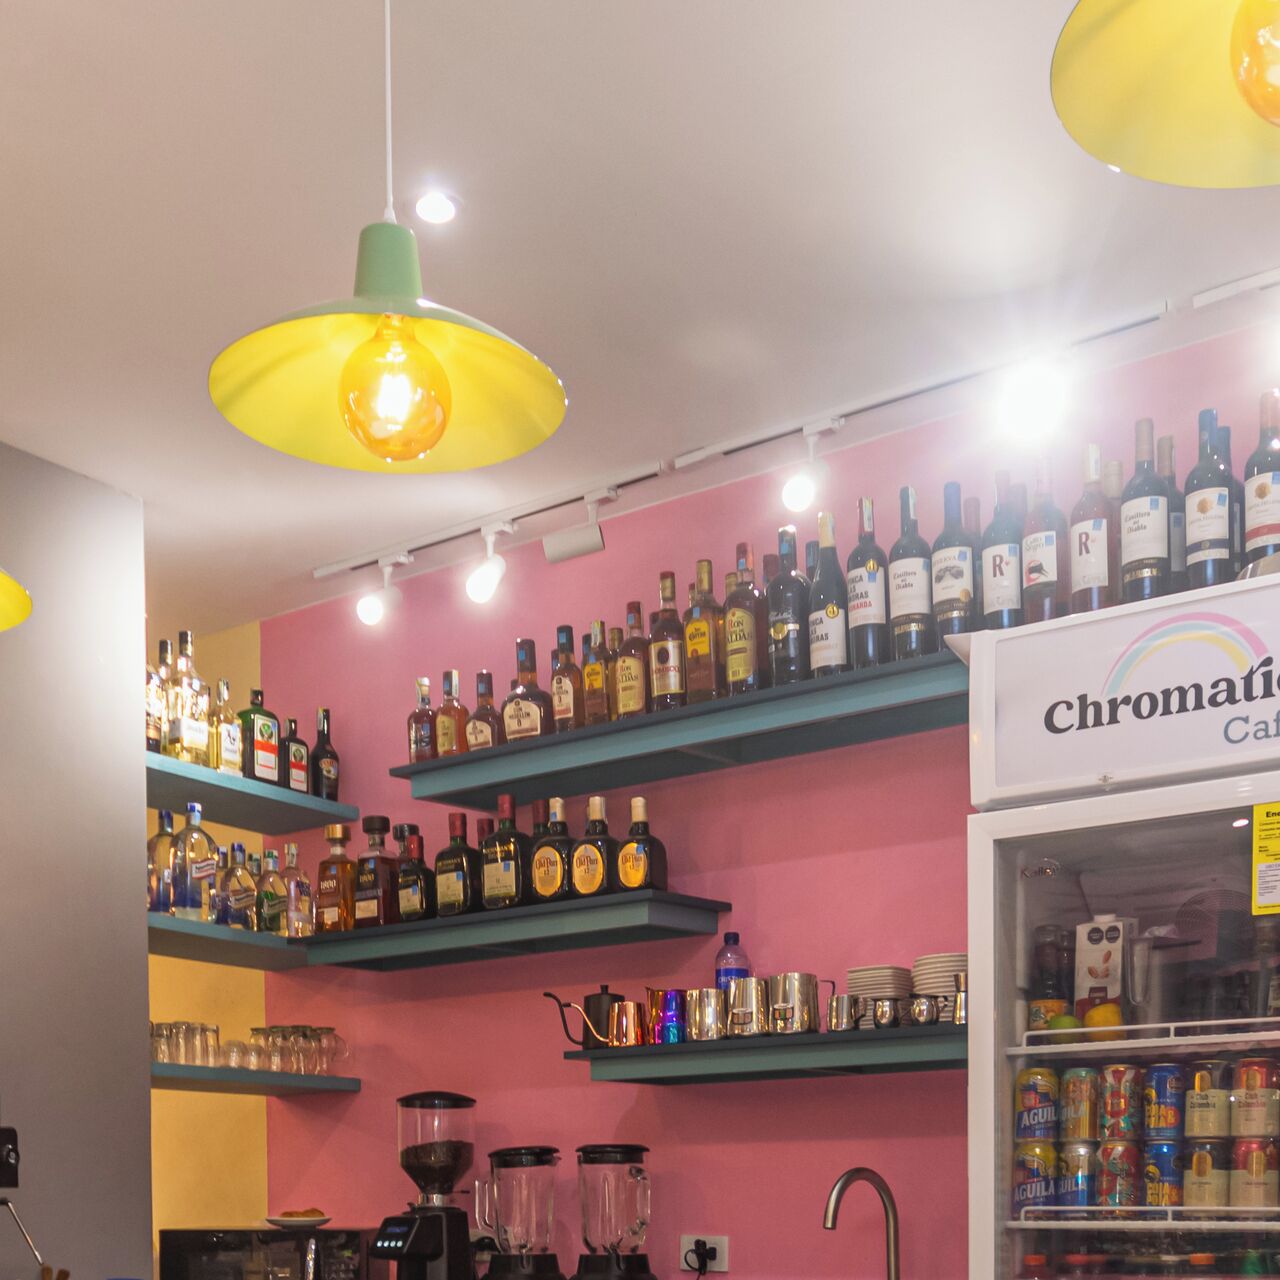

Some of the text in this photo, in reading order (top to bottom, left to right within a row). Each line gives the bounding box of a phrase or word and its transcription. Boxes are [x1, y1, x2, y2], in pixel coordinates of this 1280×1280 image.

[1078, 531, 1090, 556] R
[992, 554, 1005, 578] R
[1021, 1105, 1057, 1129] AGUIL
[1014, 1180, 1055, 1201] AGUILA
